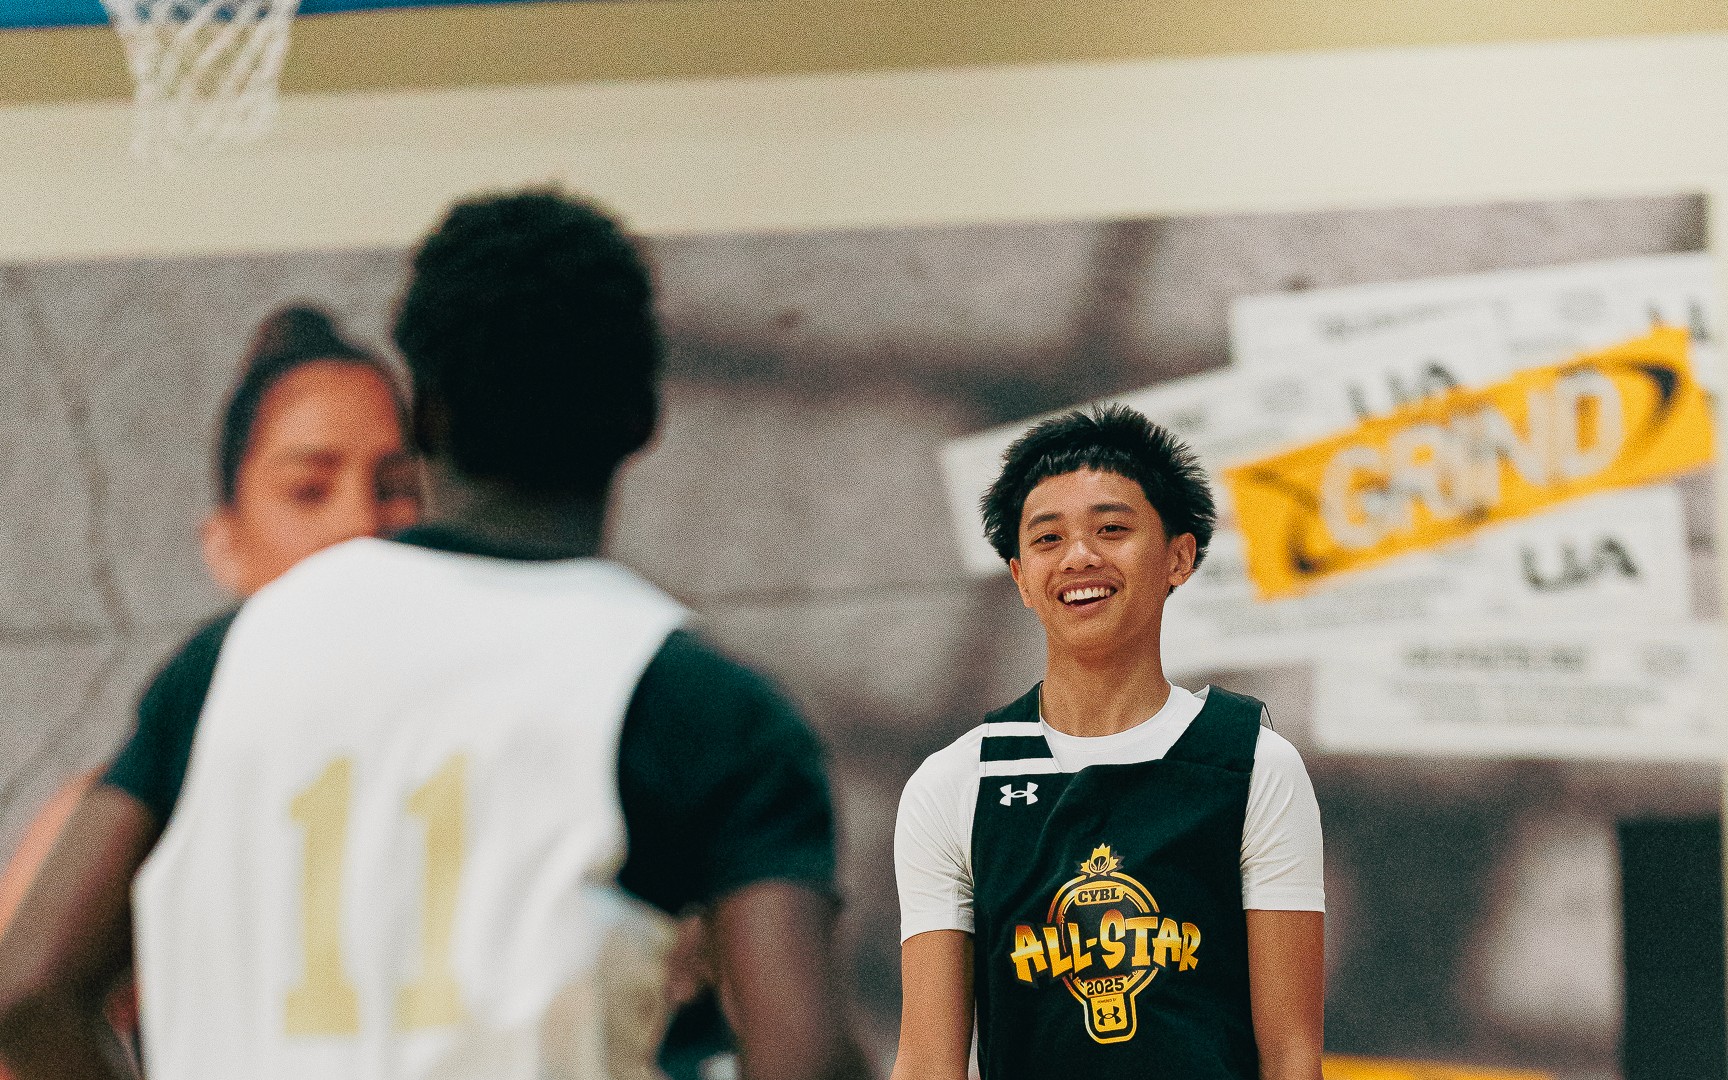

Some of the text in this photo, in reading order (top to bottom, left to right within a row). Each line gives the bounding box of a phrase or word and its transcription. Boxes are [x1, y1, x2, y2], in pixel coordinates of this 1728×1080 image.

[1322, 370, 1625, 550] GRIND
[284, 755, 470, 1036] 11
[1078, 888, 1119, 902] CYBL
[1011, 909, 1201, 982] ALL-STAR
[1087, 979, 1124, 995] 2025
